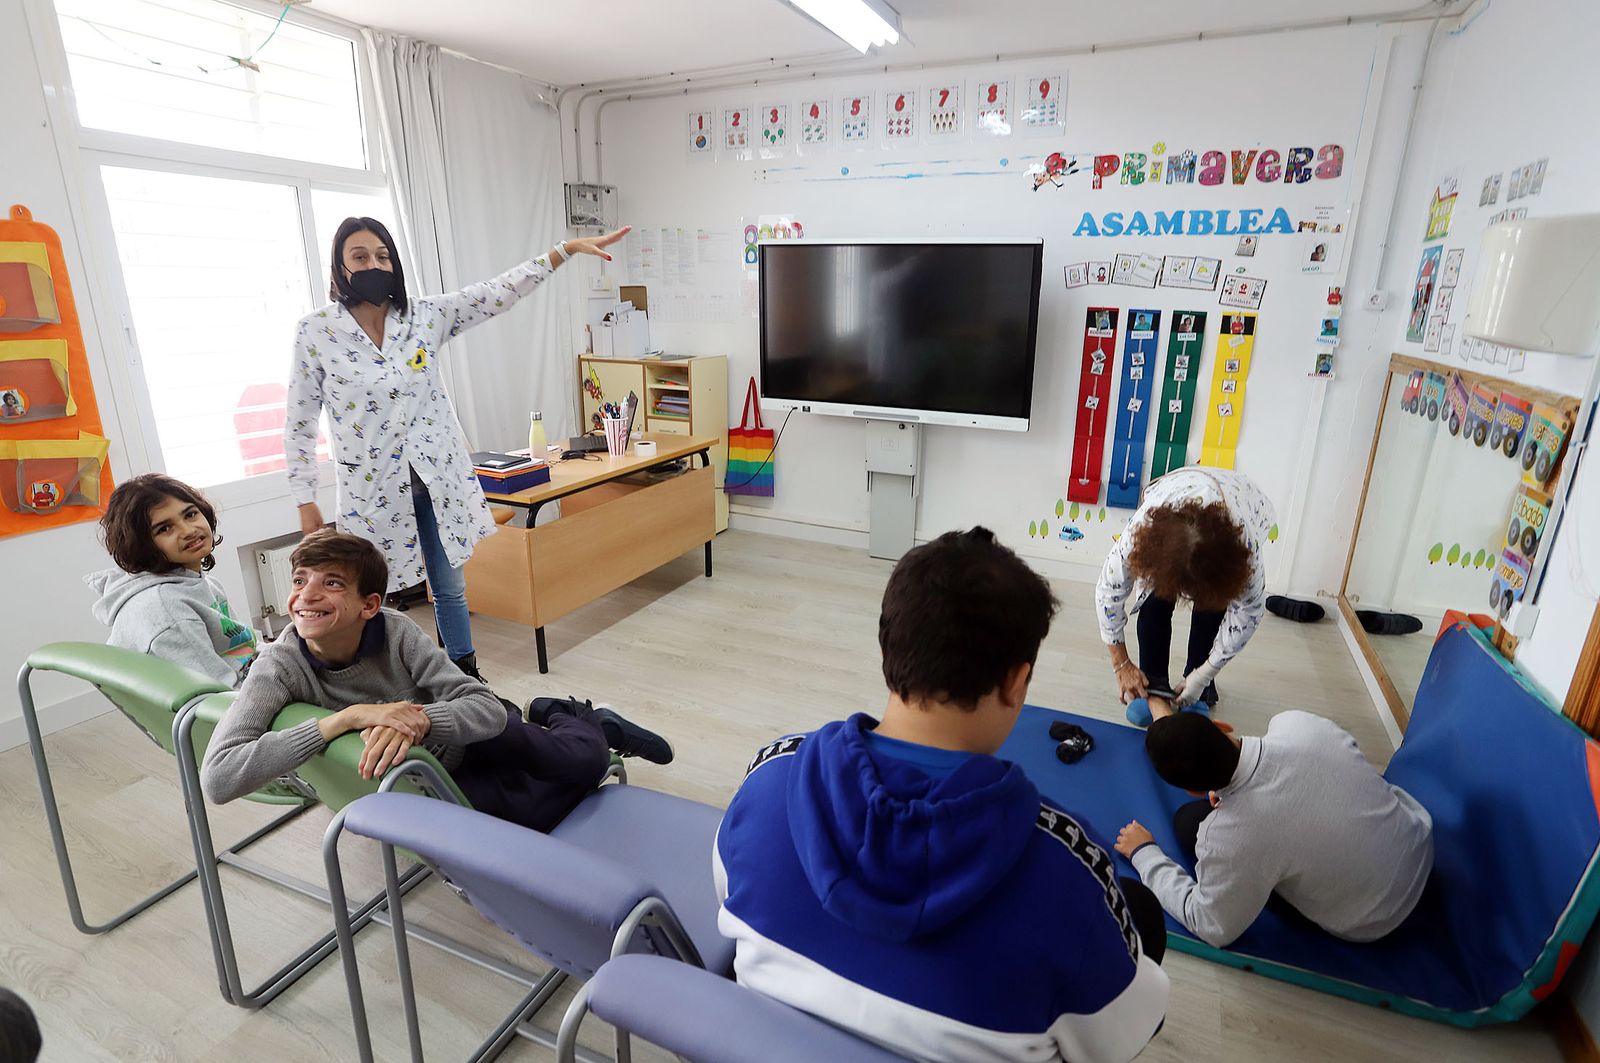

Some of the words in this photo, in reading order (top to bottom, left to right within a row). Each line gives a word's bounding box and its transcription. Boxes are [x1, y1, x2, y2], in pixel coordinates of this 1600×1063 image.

[986, 82, 998, 103] 8
[1039, 78, 1051, 99] 9
[894, 95, 906, 112] 6
[938, 88, 950, 108] 7
[769, 108, 779, 124] 3
[809, 103, 820, 119] 4
[850, 99, 861, 116] 5
[697, 115, 704, 130] 1
[732, 112, 741, 127] 2
[1072, 207, 1295, 237] ASAMBLEA
